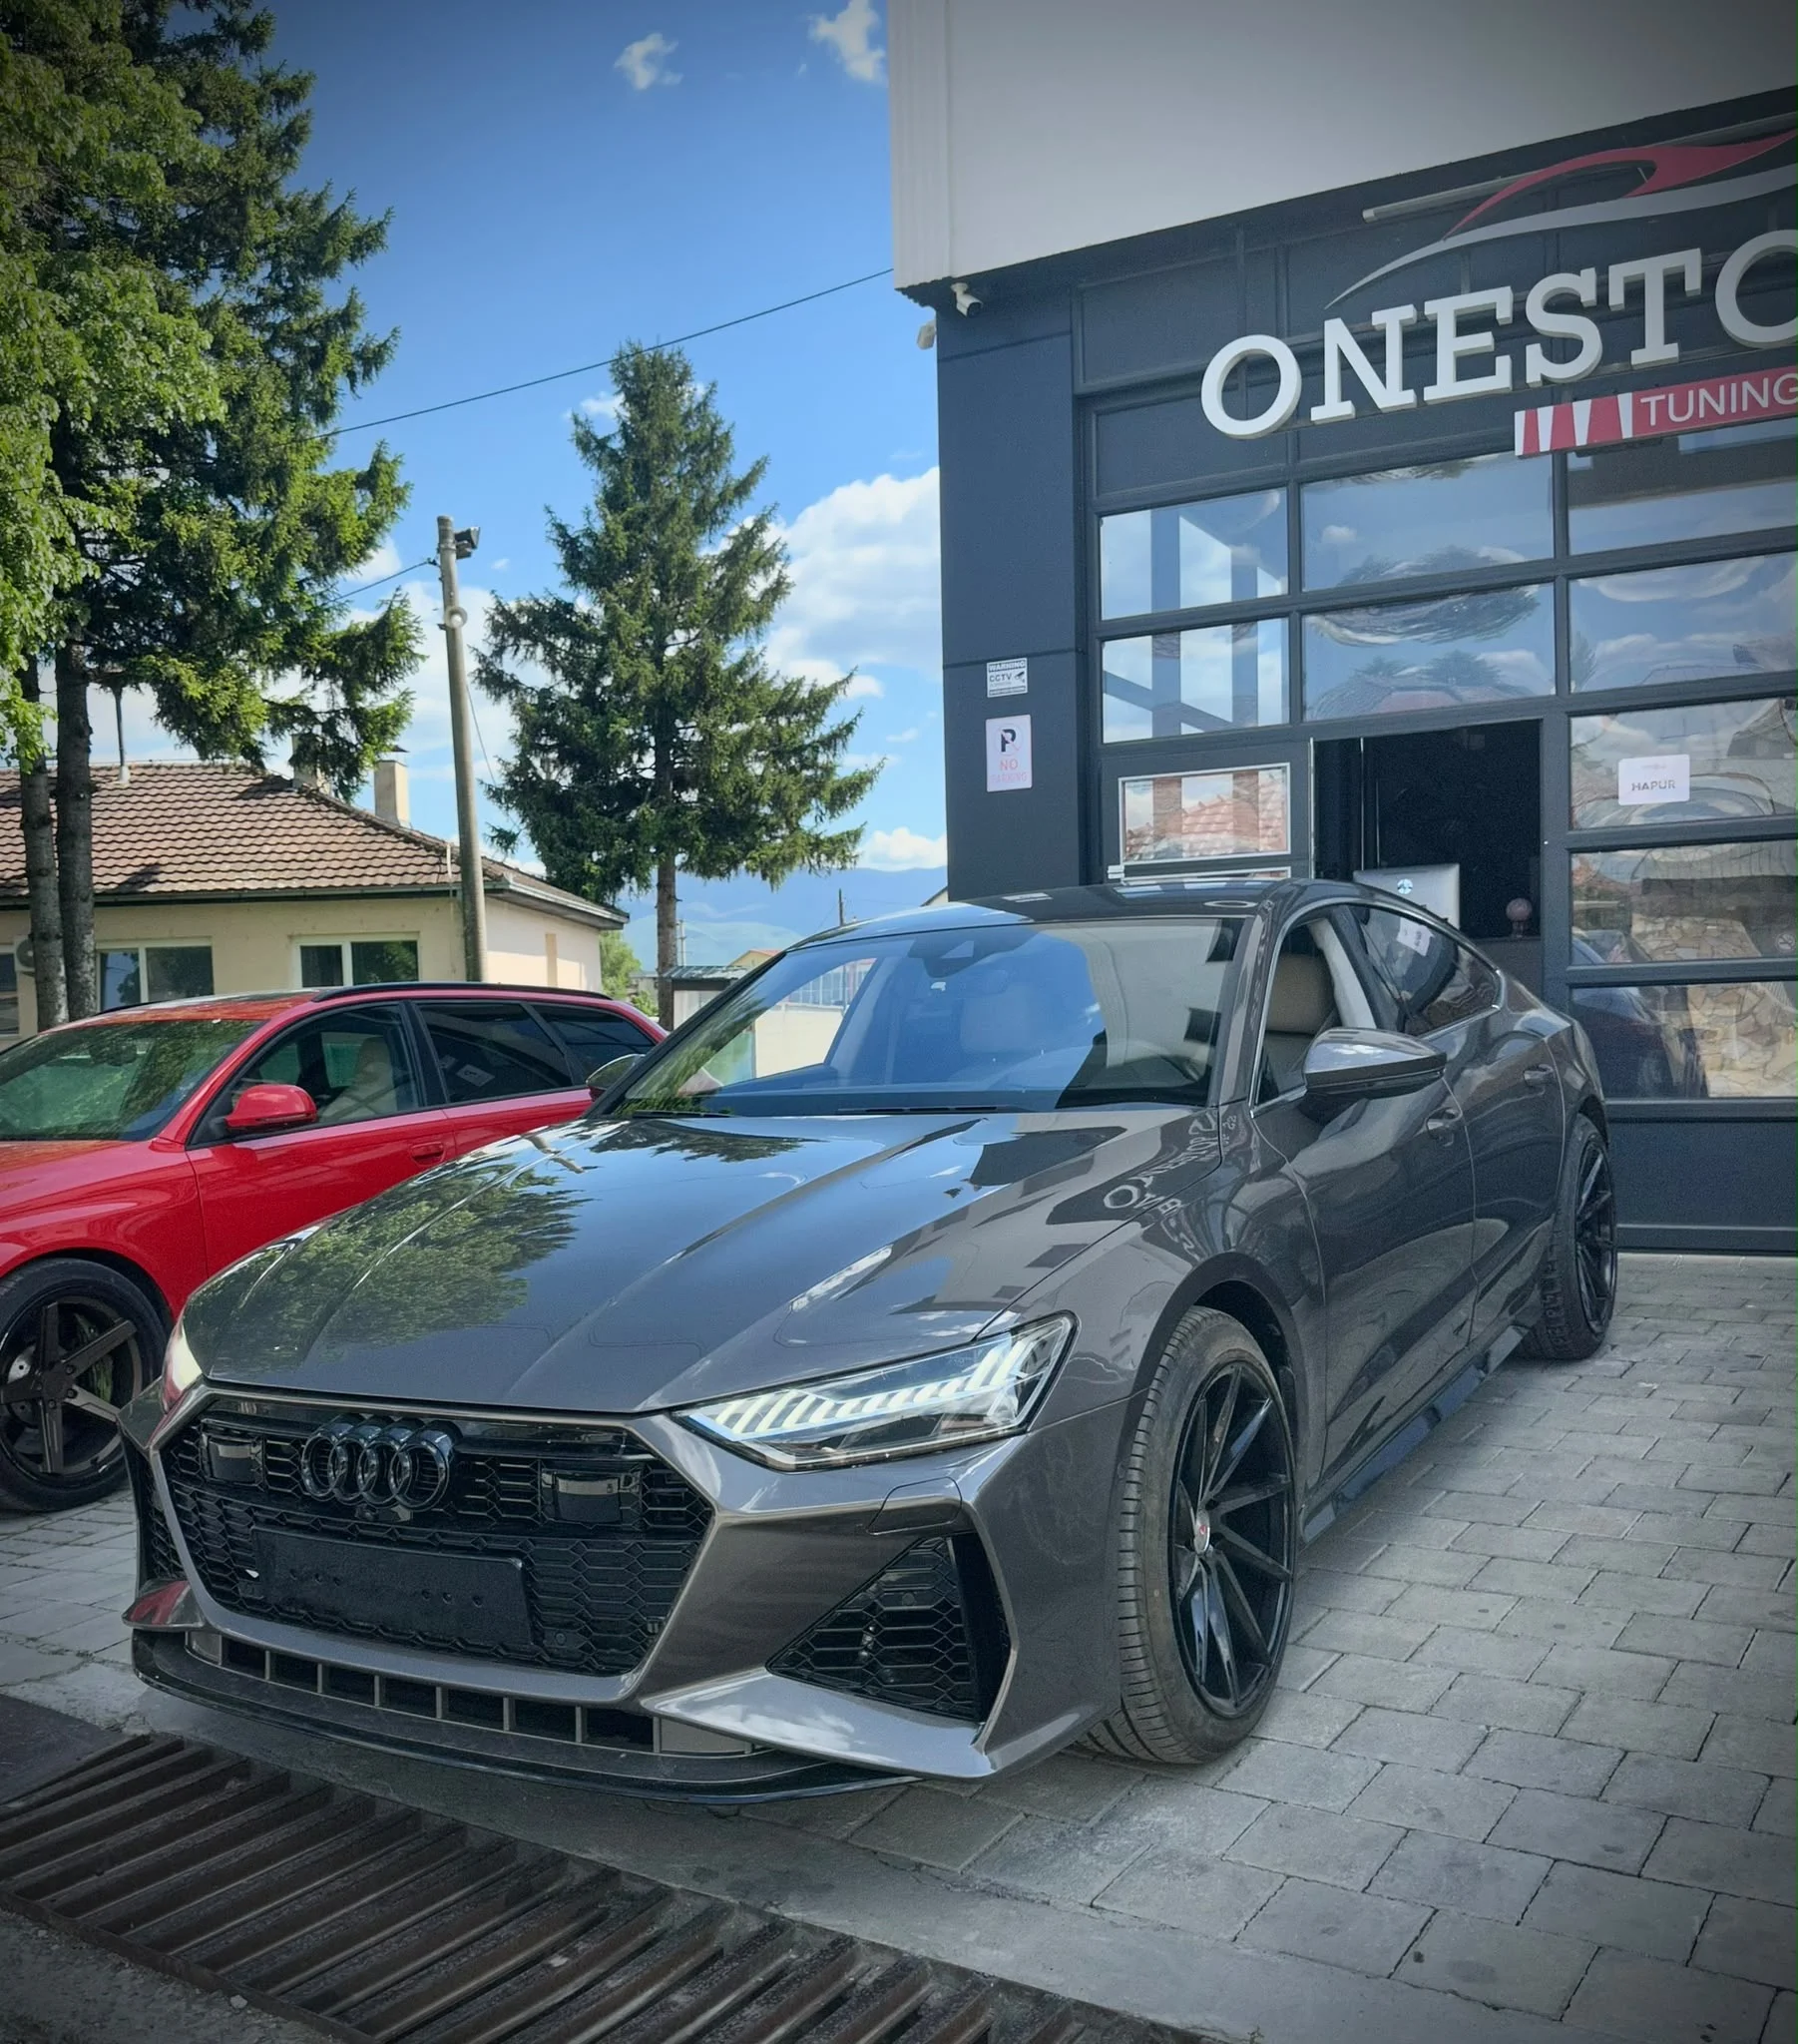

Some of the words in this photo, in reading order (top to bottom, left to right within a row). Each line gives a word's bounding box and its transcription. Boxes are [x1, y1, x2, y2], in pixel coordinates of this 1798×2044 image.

[1639, 372, 1798, 427] TUNING
[989, 674, 1012, 683] CCTV
[1001, 729, 1017, 753] P
[1000, 759, 1019, 771] NO
[1631, 779, 1675, 791] HAPUR
